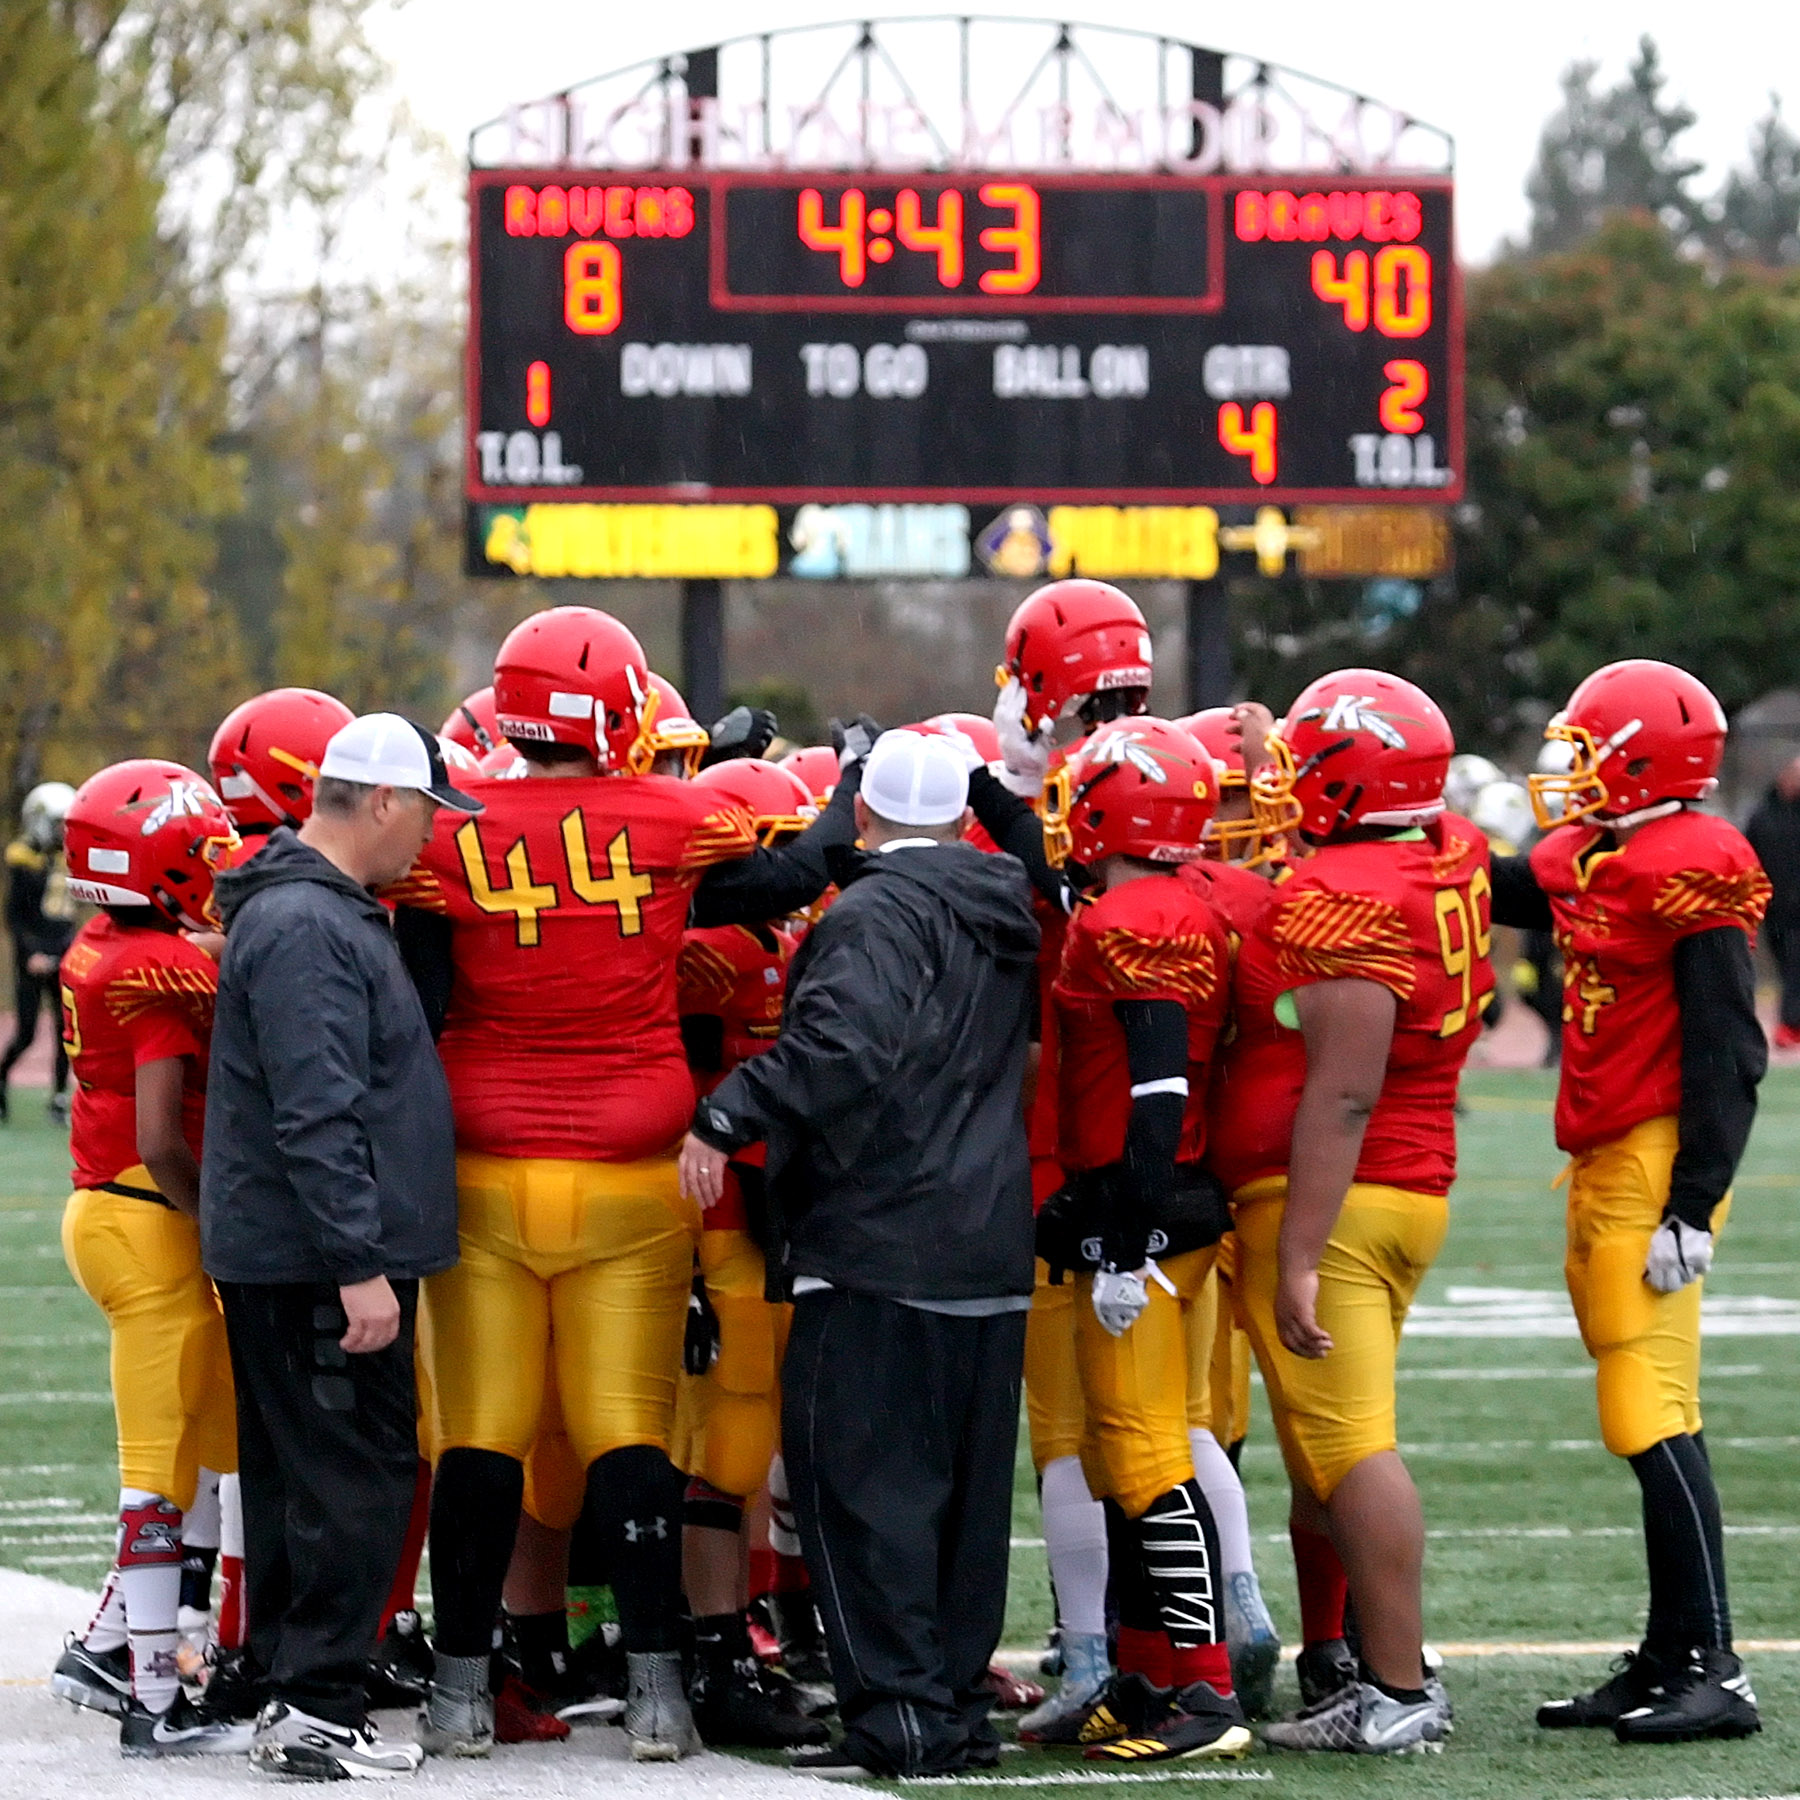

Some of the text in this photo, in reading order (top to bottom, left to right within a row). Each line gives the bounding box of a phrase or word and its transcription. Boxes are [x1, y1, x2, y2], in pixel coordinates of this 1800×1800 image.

[505, 185, 695, 238] RAVENS
[798, 184, 1041, 295] 4:43
[1235, 190, 1423, 243] BRAVES
[564, 240, 623, 336] 8
[1311, 244, 1432, 338] 40
[526, 360, 551, 427] 1
[620, 343, 753, 397] DOWN
[799, 343, 929, 398] TO GO
[992, 345, 1150, 399] BALL ON
[1203, 345, 1291, 400] QTR
[1379, 359, 1429, 434] 2
[1217, 401, 1278, 485] 4
[455, 806, 654, 947] 44
